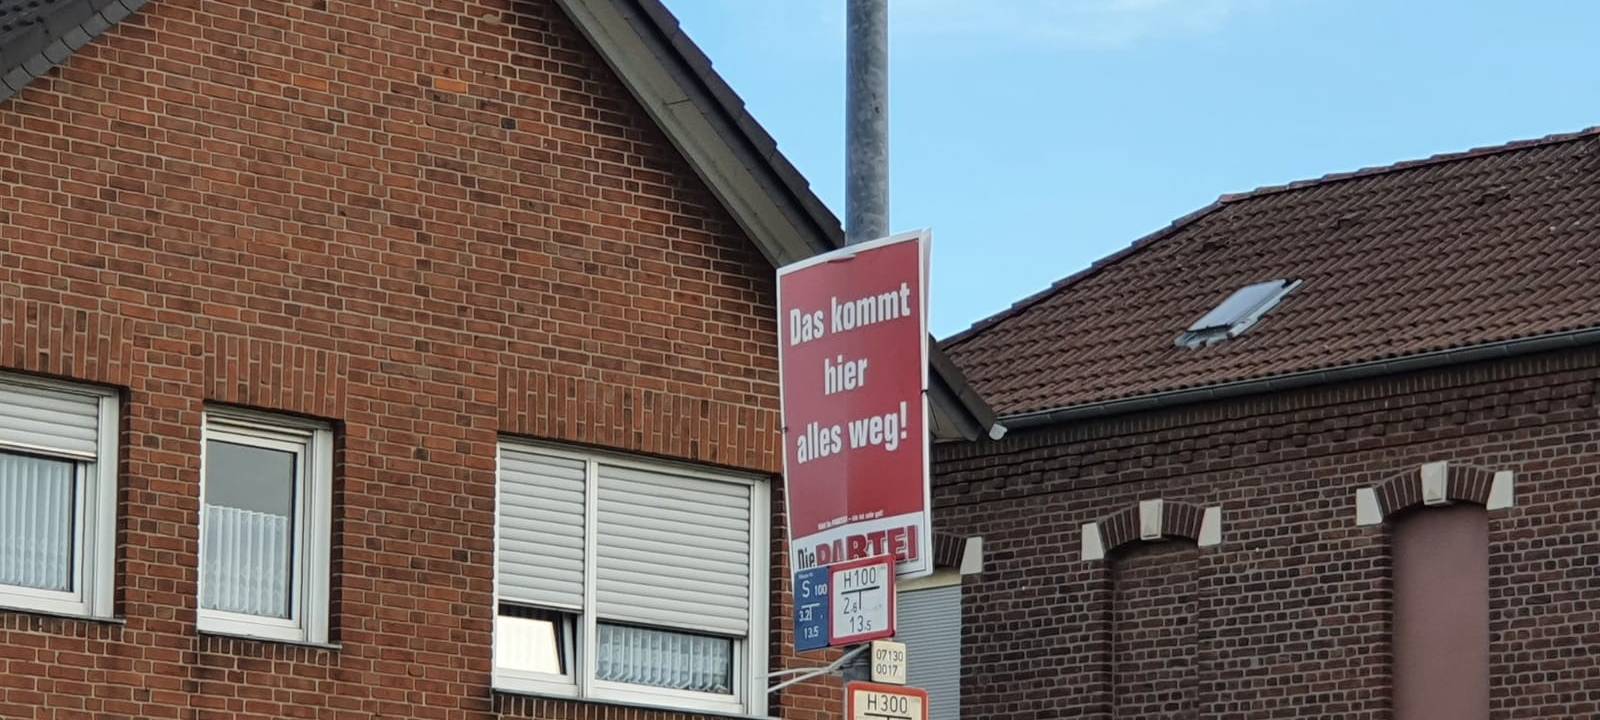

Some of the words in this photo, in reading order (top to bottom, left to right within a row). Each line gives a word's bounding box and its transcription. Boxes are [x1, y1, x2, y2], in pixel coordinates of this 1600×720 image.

[790, 308, 824, 346] Das
[831, 282, 911, 334] kommt
[824, 354, 868, 395] hier
[797, 421, 842, 464] alles
[848, 401, 907, 451] weg!
[797, 547, 816, 569] Die
[816, 524, 918, 566] PARTEI
[802, 580, 810, 598] S
[814, 583, 828, 596] 100
[843, 567, 876, 589] H100
[876, 649, 904, 662] 07130
[876, 663, 898, 676] 0017
[867, 693, 908, 714] H300
